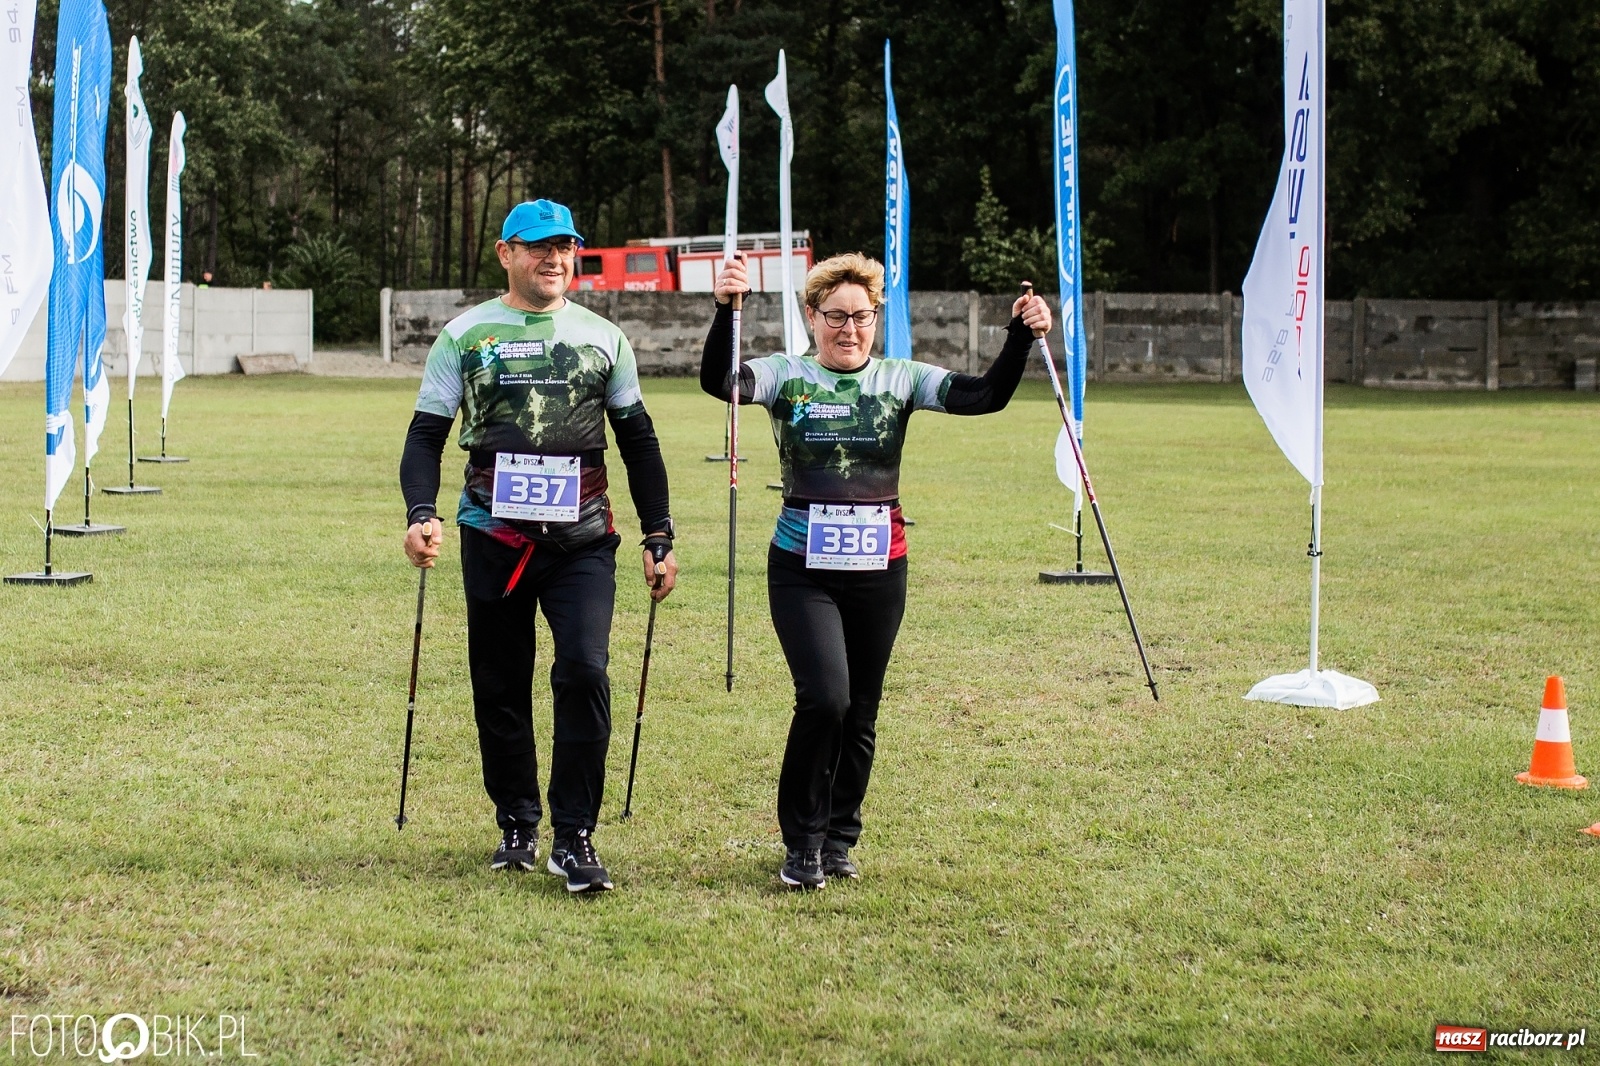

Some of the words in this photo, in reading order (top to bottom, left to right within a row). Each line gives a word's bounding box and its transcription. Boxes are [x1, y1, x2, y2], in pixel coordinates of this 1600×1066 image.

[6, 0, 22, 43] 94.
[1, 254, 19, 295] FM
[523, 457, 545, 467] DYSZA
[509, 475, 568, 505] 337
[822, 526, 878, 554] 336
